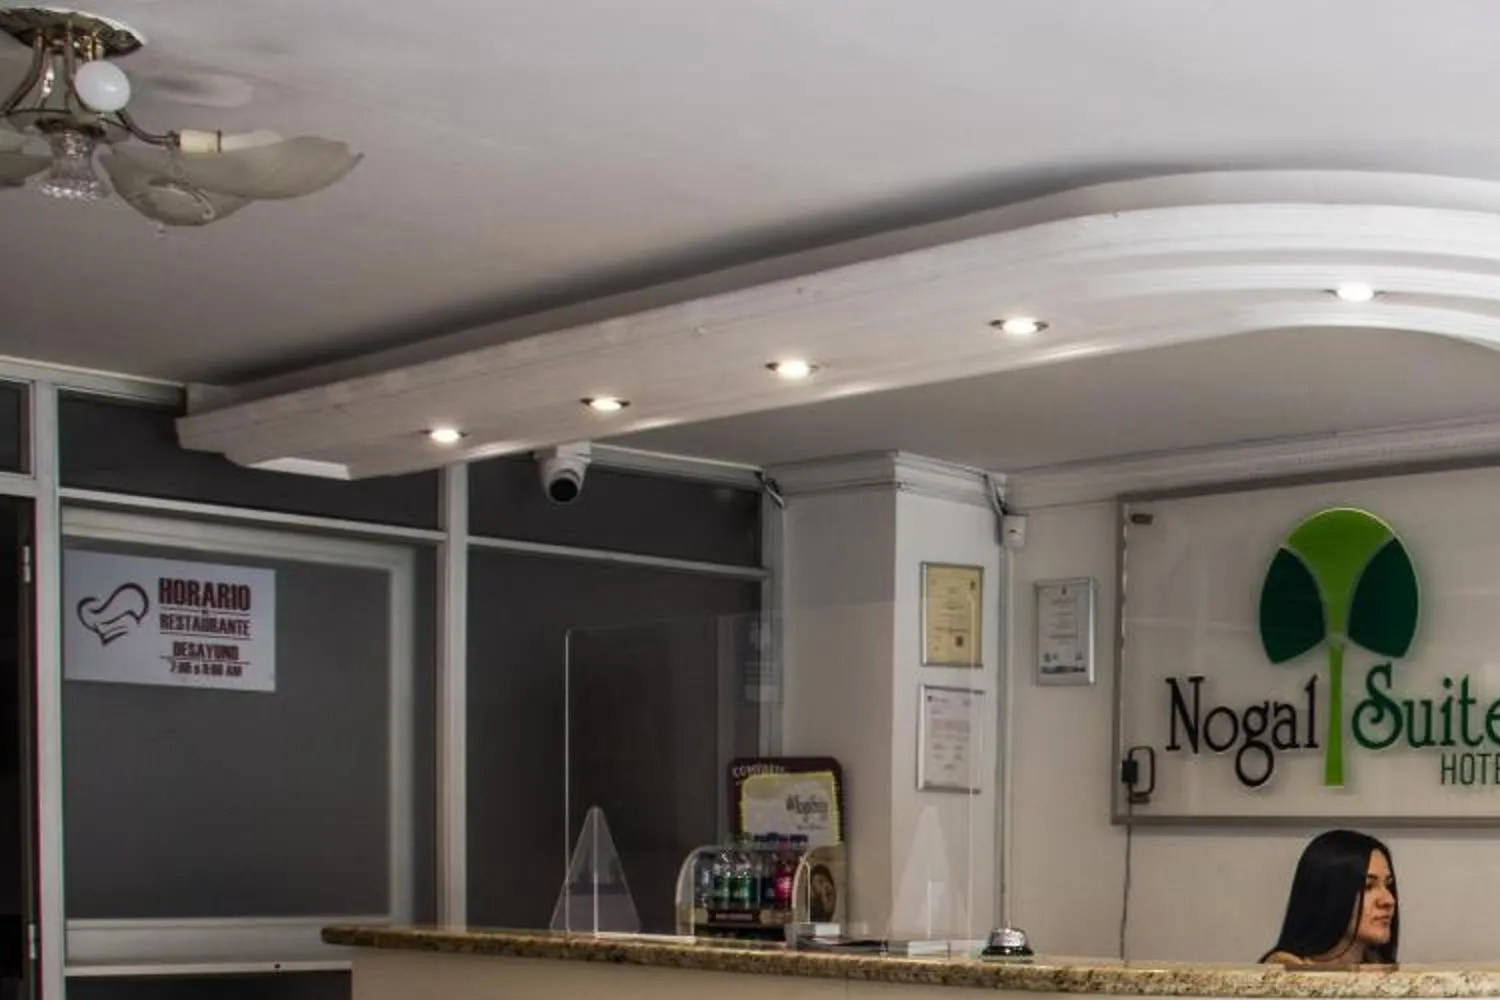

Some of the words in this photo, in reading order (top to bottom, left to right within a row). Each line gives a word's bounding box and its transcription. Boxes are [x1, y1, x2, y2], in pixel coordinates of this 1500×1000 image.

[158, 577, 252, 611] HORARIO
[159, 613, 251, 637] RESTAURANTE
[173, 641, 240, 661] DESAYUNO
[1165, 674, 1319, 787] Nogal
